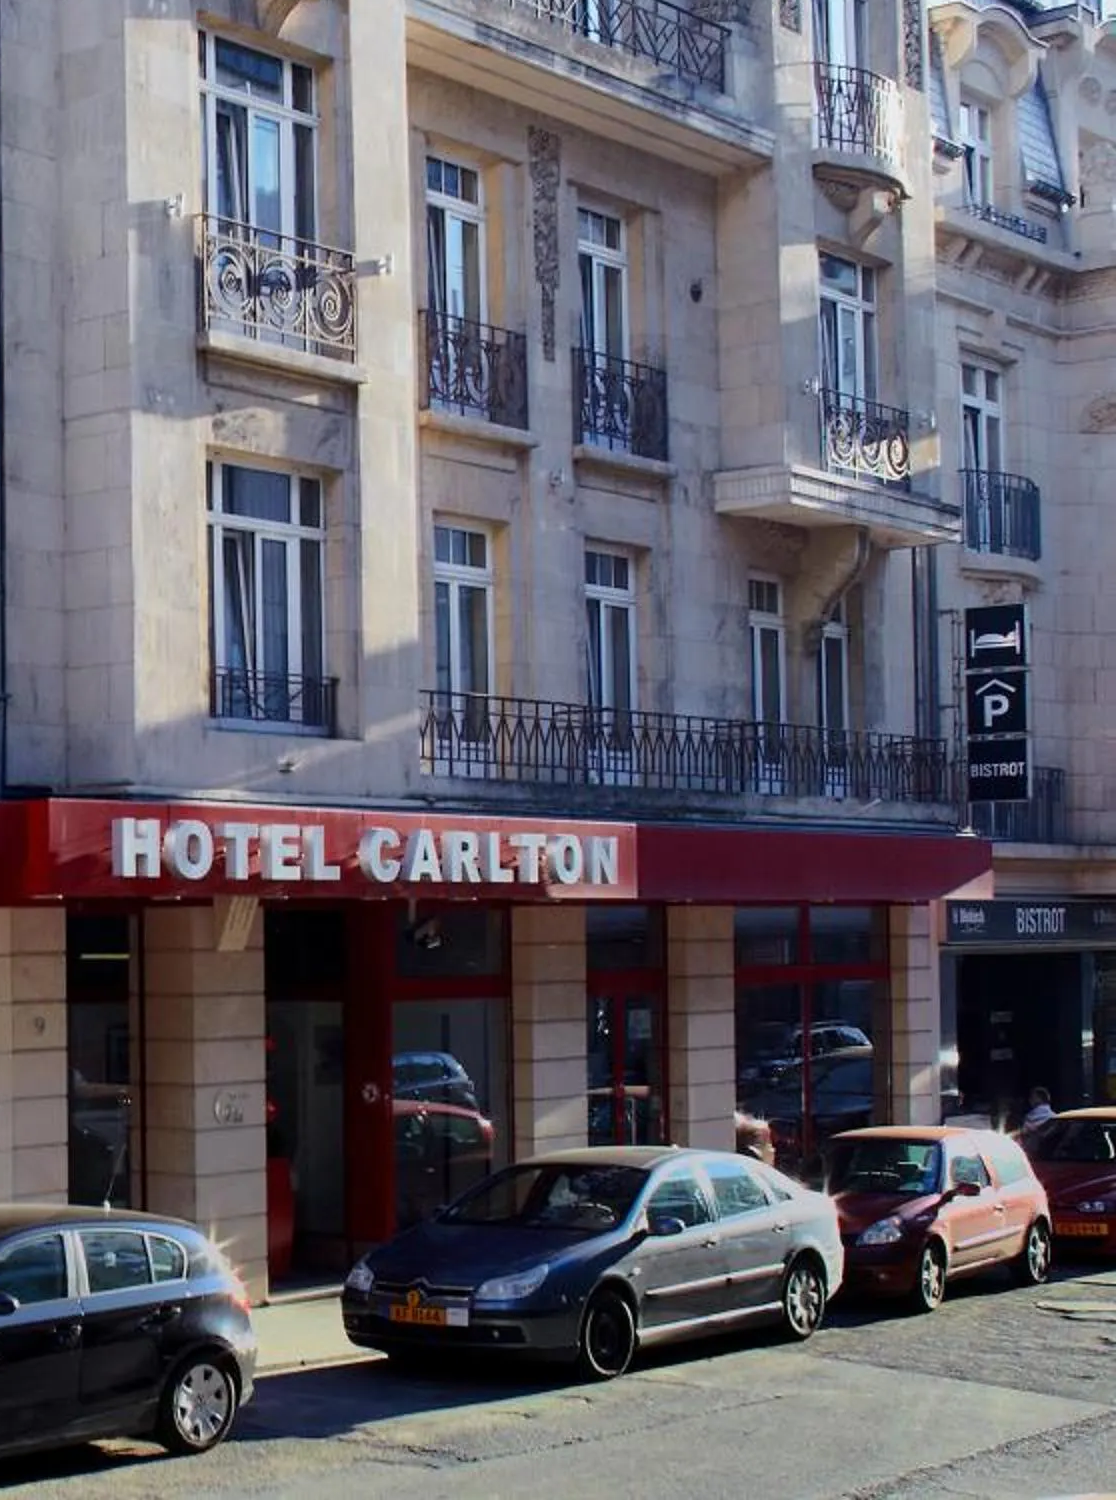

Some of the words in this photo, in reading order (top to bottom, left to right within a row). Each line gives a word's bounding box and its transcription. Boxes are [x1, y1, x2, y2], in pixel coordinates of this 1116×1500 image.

[984, 693, 1009, 727] P
[970, 761, 1025, 778] BISTROT
[112, 817, 340, 882] HOTEL
[358, 826, 619, 885] CARLTON
[1016, 907, 1066, 933] BISTROT
